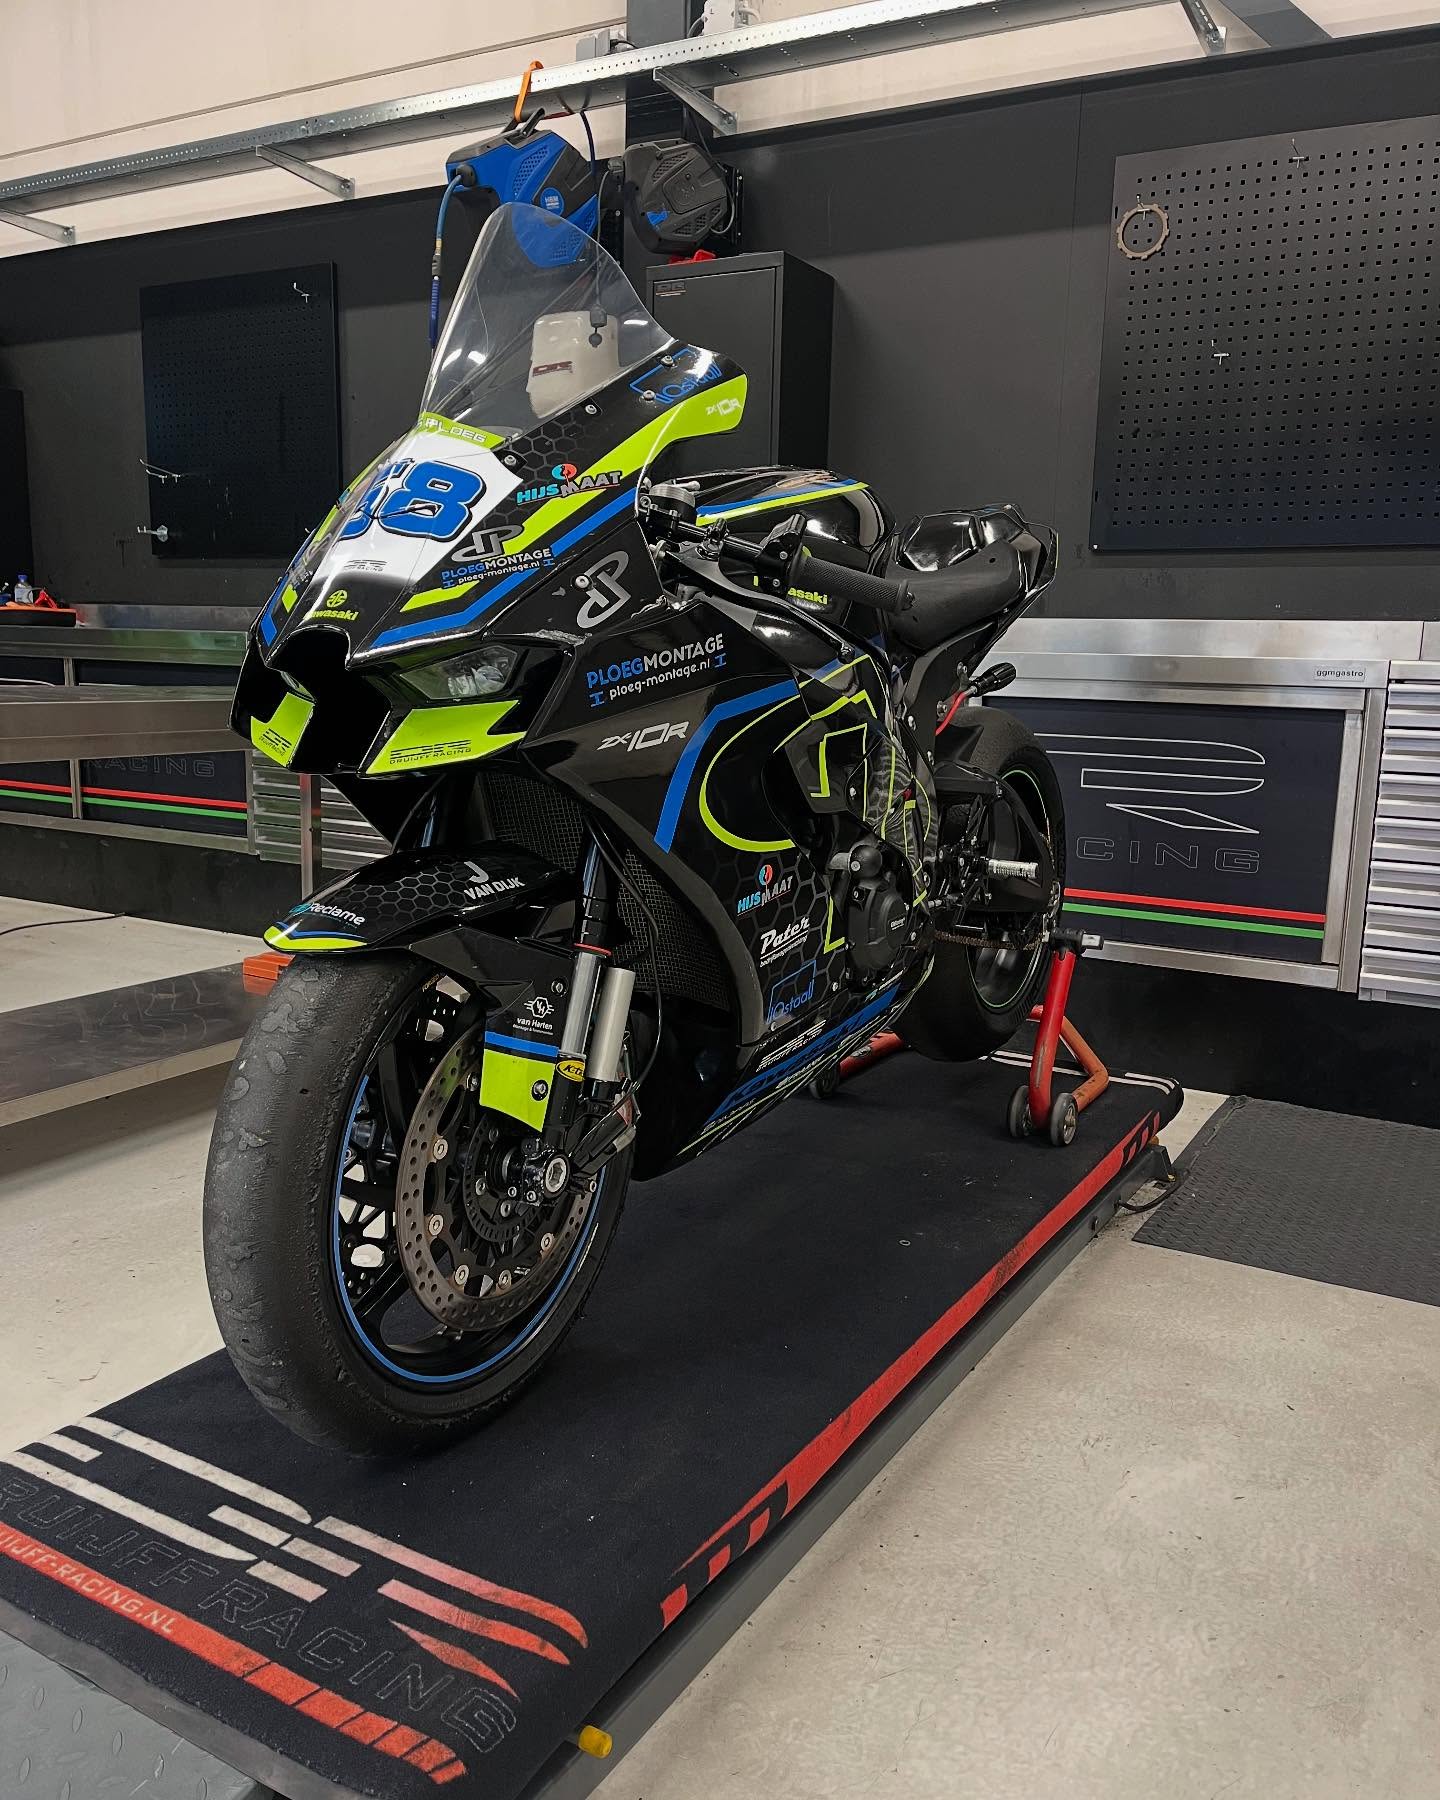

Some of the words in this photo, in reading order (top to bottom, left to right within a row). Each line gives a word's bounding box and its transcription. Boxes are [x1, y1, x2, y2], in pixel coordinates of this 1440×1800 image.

[516, 471, 622, 504] HIJSMAAT
[441, 548, 553, 581] PLOEGMONTAGE
[457, 560, 541, 585] ploeg-montage.nl
[586, 633, 724, 689] PLOEGMONTAGE
[1315, 669, 1364, 679] ggmgastro
[609, 658, 710, 700] ploeg-montage.nl
[1076, 836, 1260, 874] CING
[463, 883, 496, 900] VAN
[491, 876, 526, 892] DIJK
